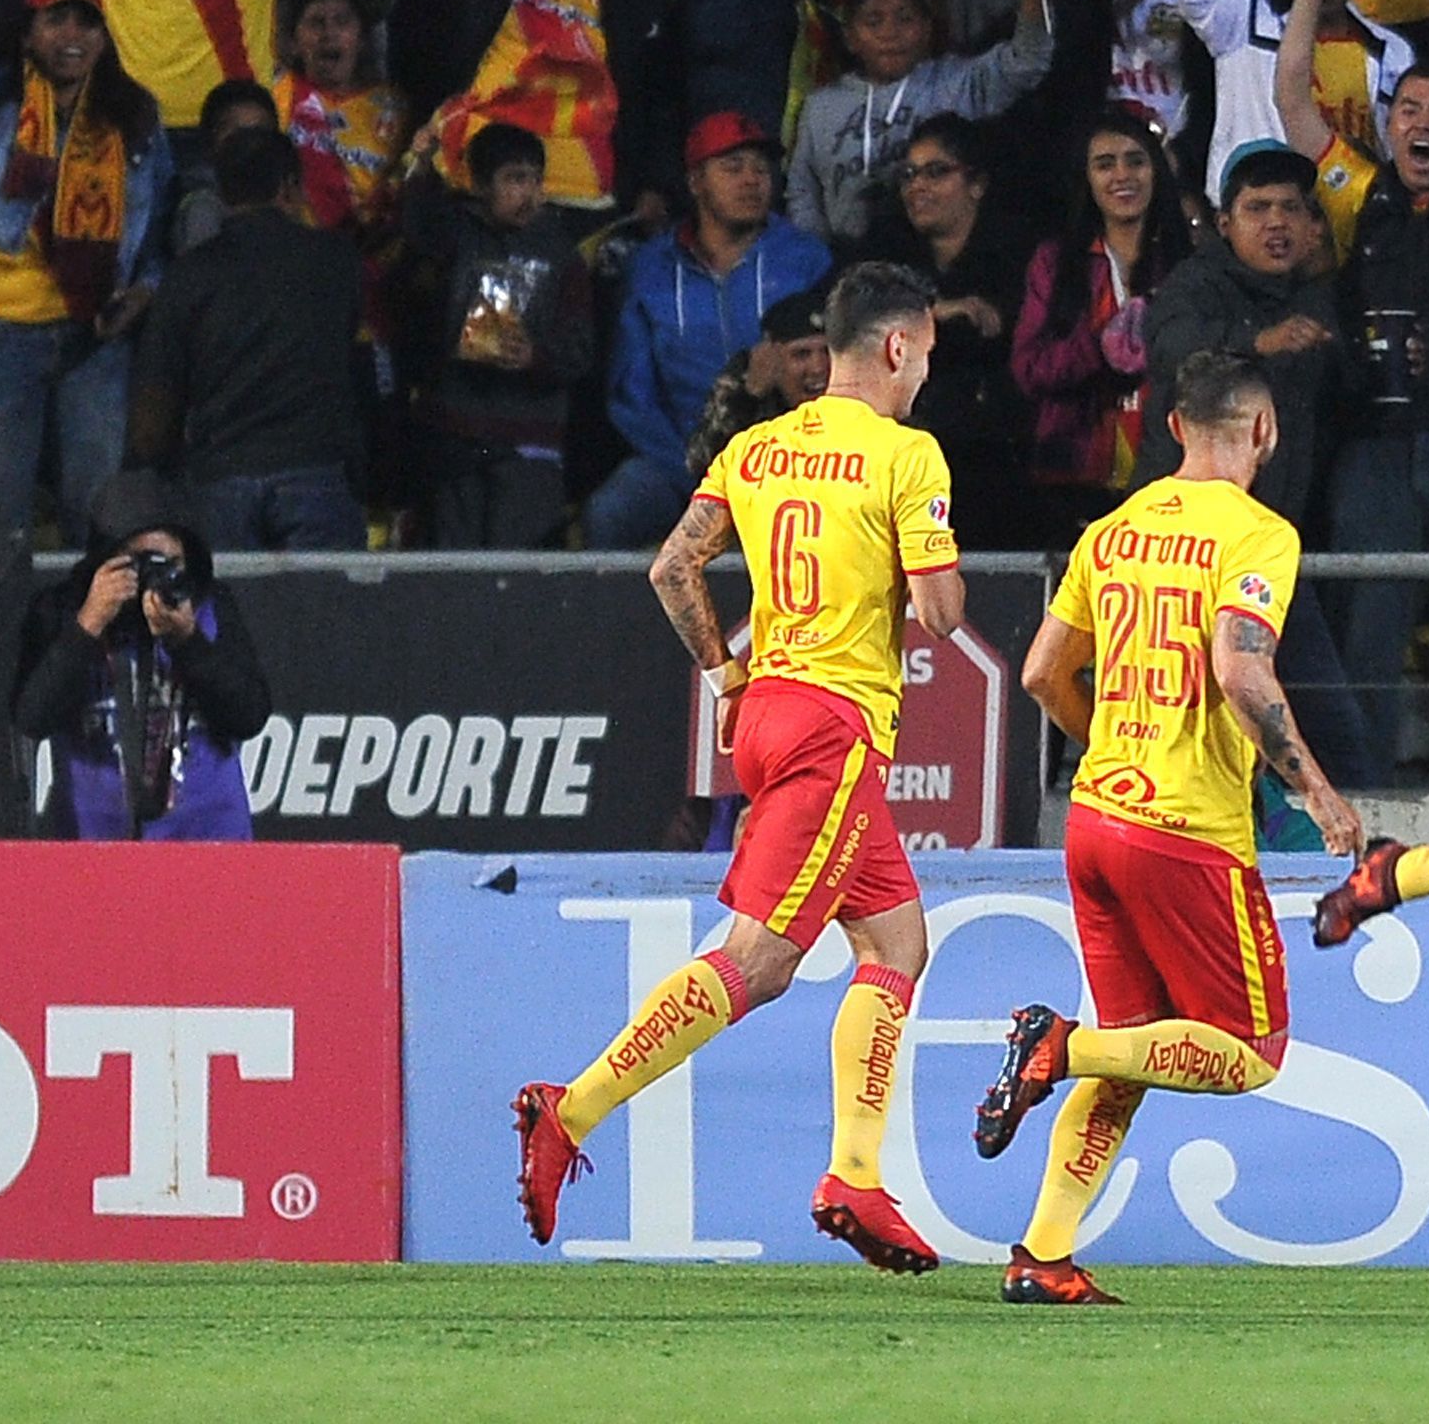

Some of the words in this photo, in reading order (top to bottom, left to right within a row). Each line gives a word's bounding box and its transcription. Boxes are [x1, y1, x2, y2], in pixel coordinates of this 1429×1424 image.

[739, 435, 866, 489] Corona
[770, 499, 821, 616] 6
[1092, 519, 1217, 576] Corona
[1098, 581, 1208, 709] 25
[241, 713, 608, 818] DEPORTE
[606, 993, 695, 1079] Totalplay
[855, 1017, 902, 1114] Totalplay
[1141, 1032, 1229, 1087] Totalplay
